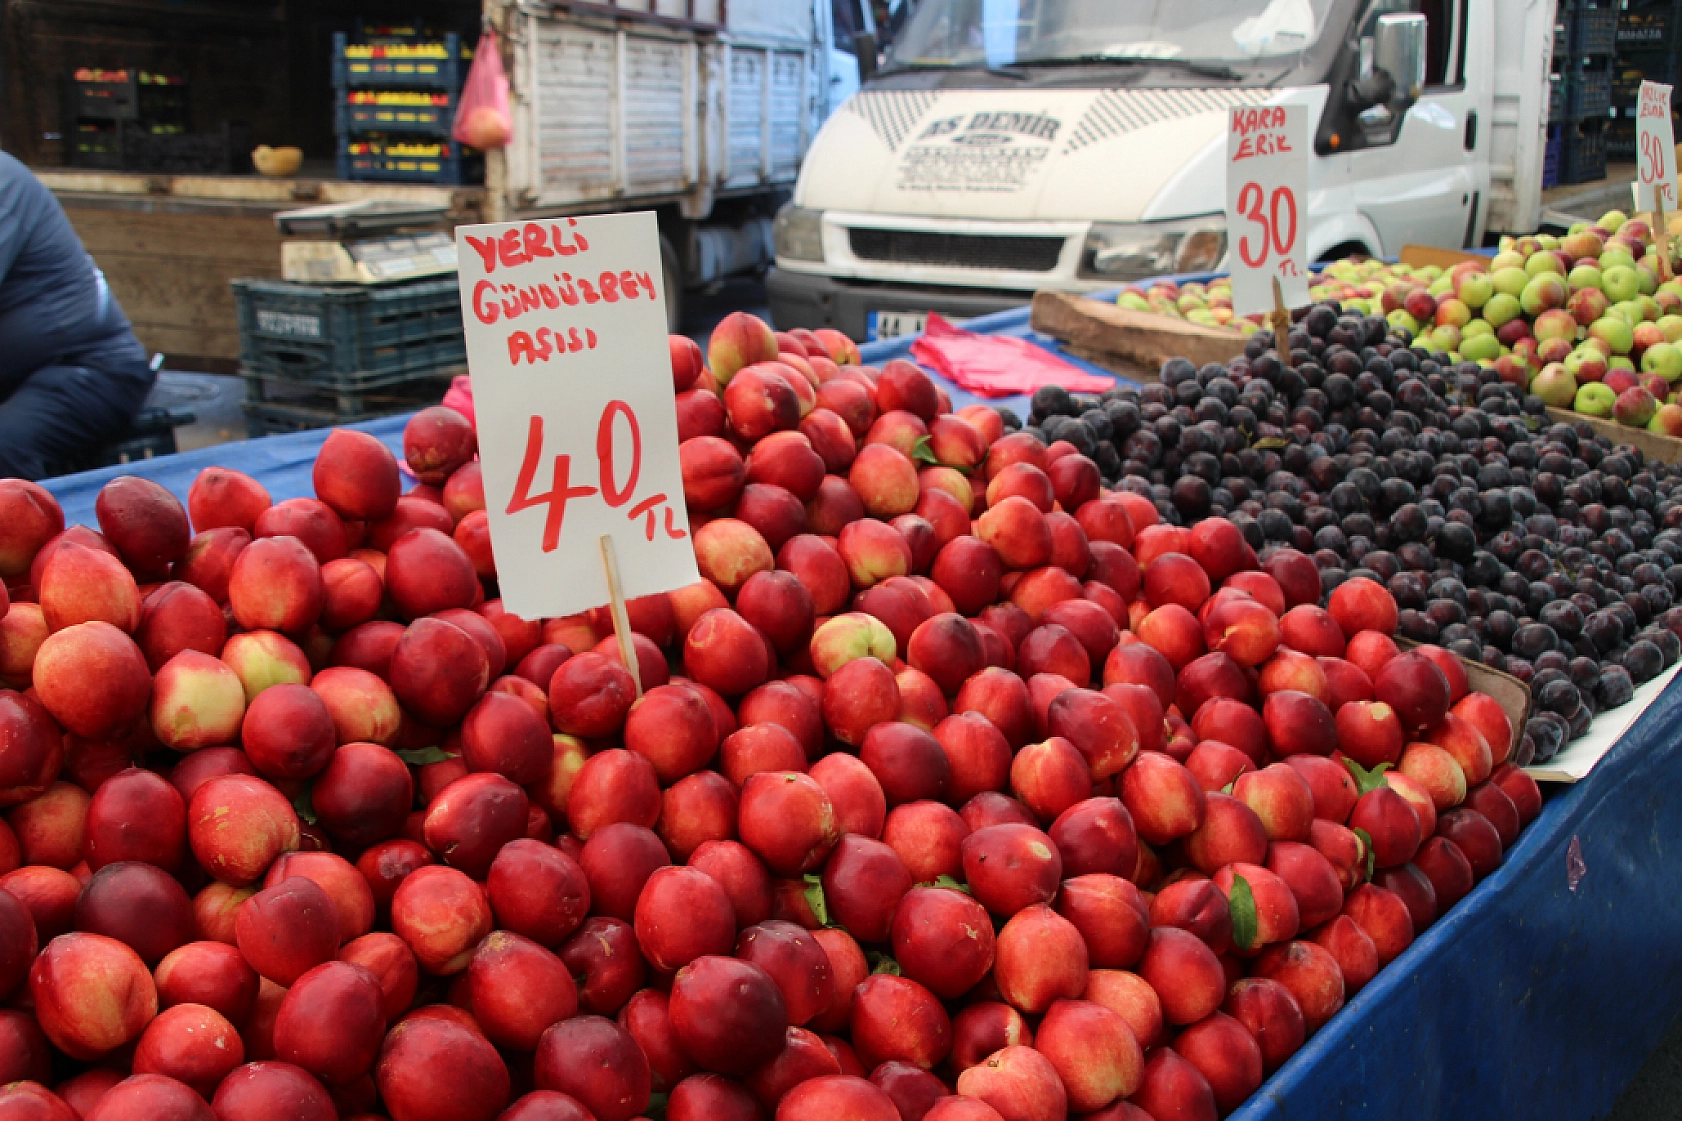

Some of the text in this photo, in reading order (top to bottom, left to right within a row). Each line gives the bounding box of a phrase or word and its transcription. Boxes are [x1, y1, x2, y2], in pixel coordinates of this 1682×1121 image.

[1232, 105, 1286, 136] KARA
[1640, 129, 1665, 185] 30
[1236, 181, 1298, 269] 30
[506, 326, 598, 366] AŞISI
[505, 399, 642, 553] 40
[627, 492, 688, 542] TL
